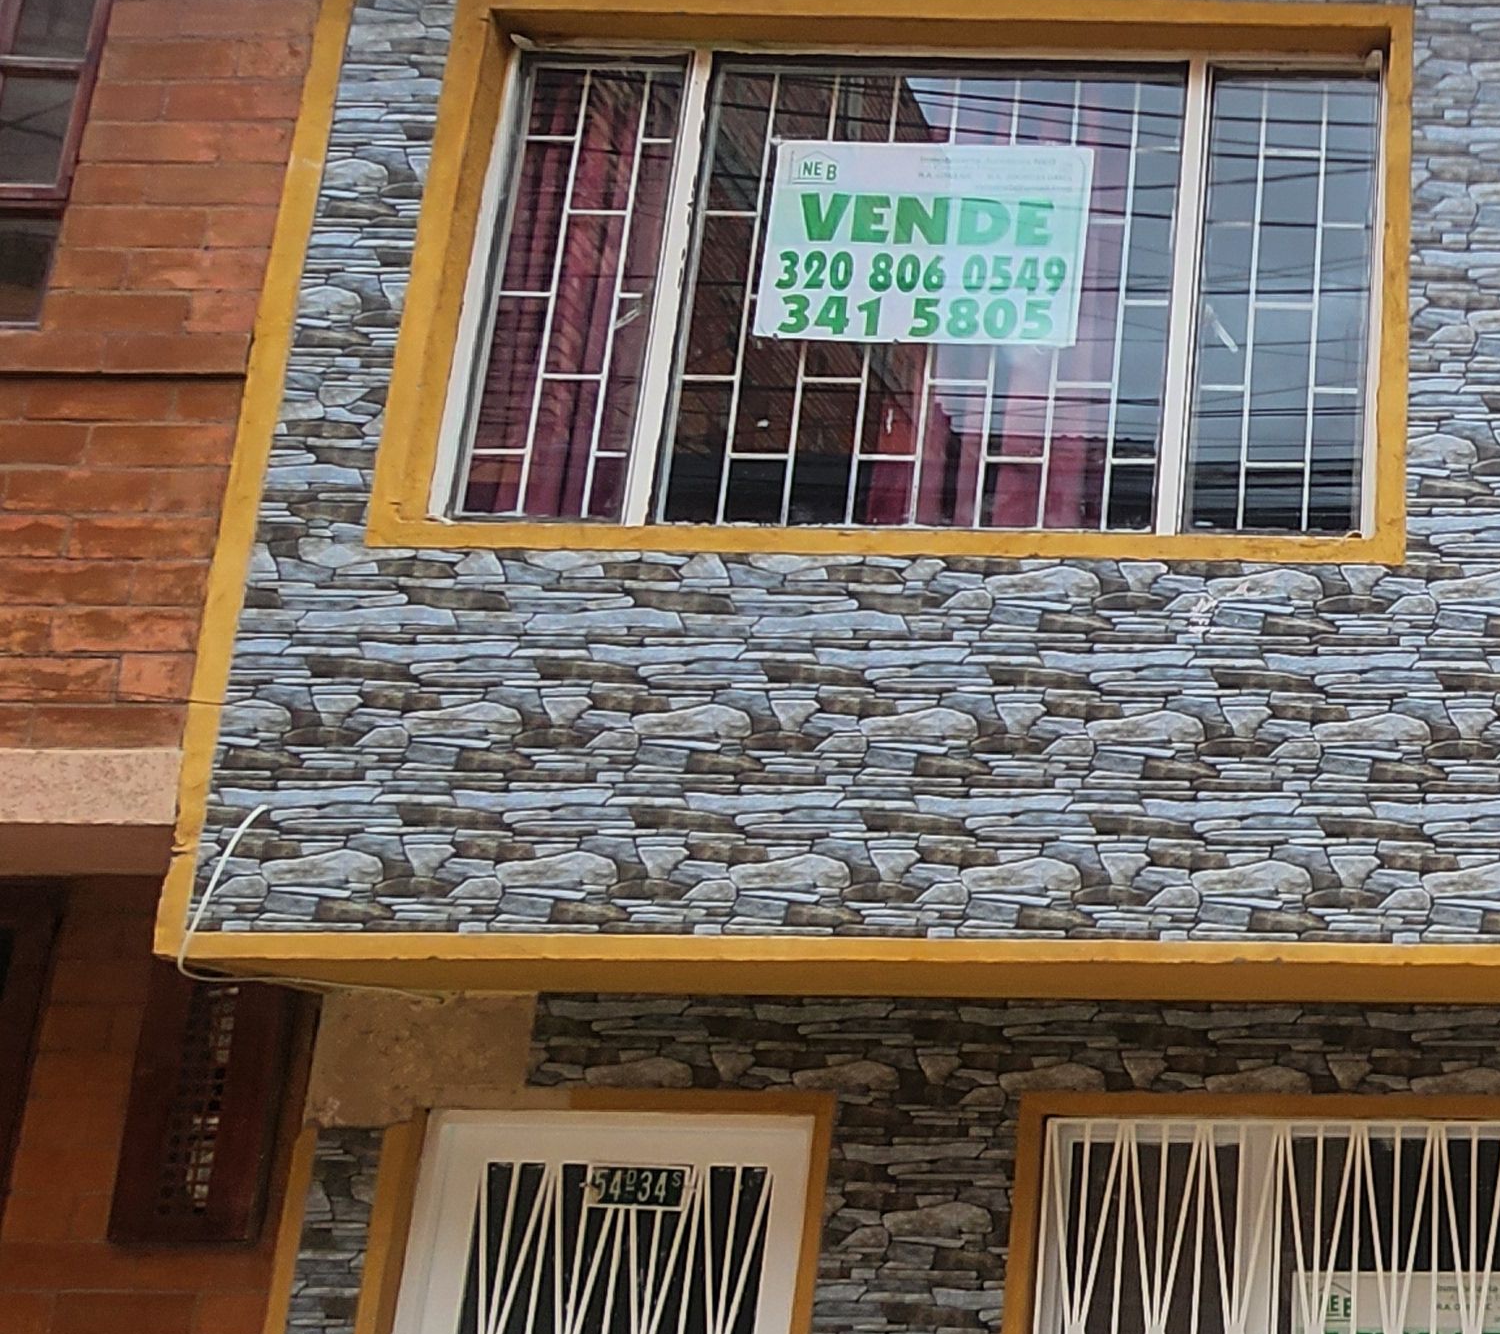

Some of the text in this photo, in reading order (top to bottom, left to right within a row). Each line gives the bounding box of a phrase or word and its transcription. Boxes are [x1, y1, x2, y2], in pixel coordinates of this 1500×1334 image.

[800, 193, 1055, 246] VENDE
[775, 250, 1068, 295] 320 806 0549
[777, 294, 1054, 339] 341 5805
